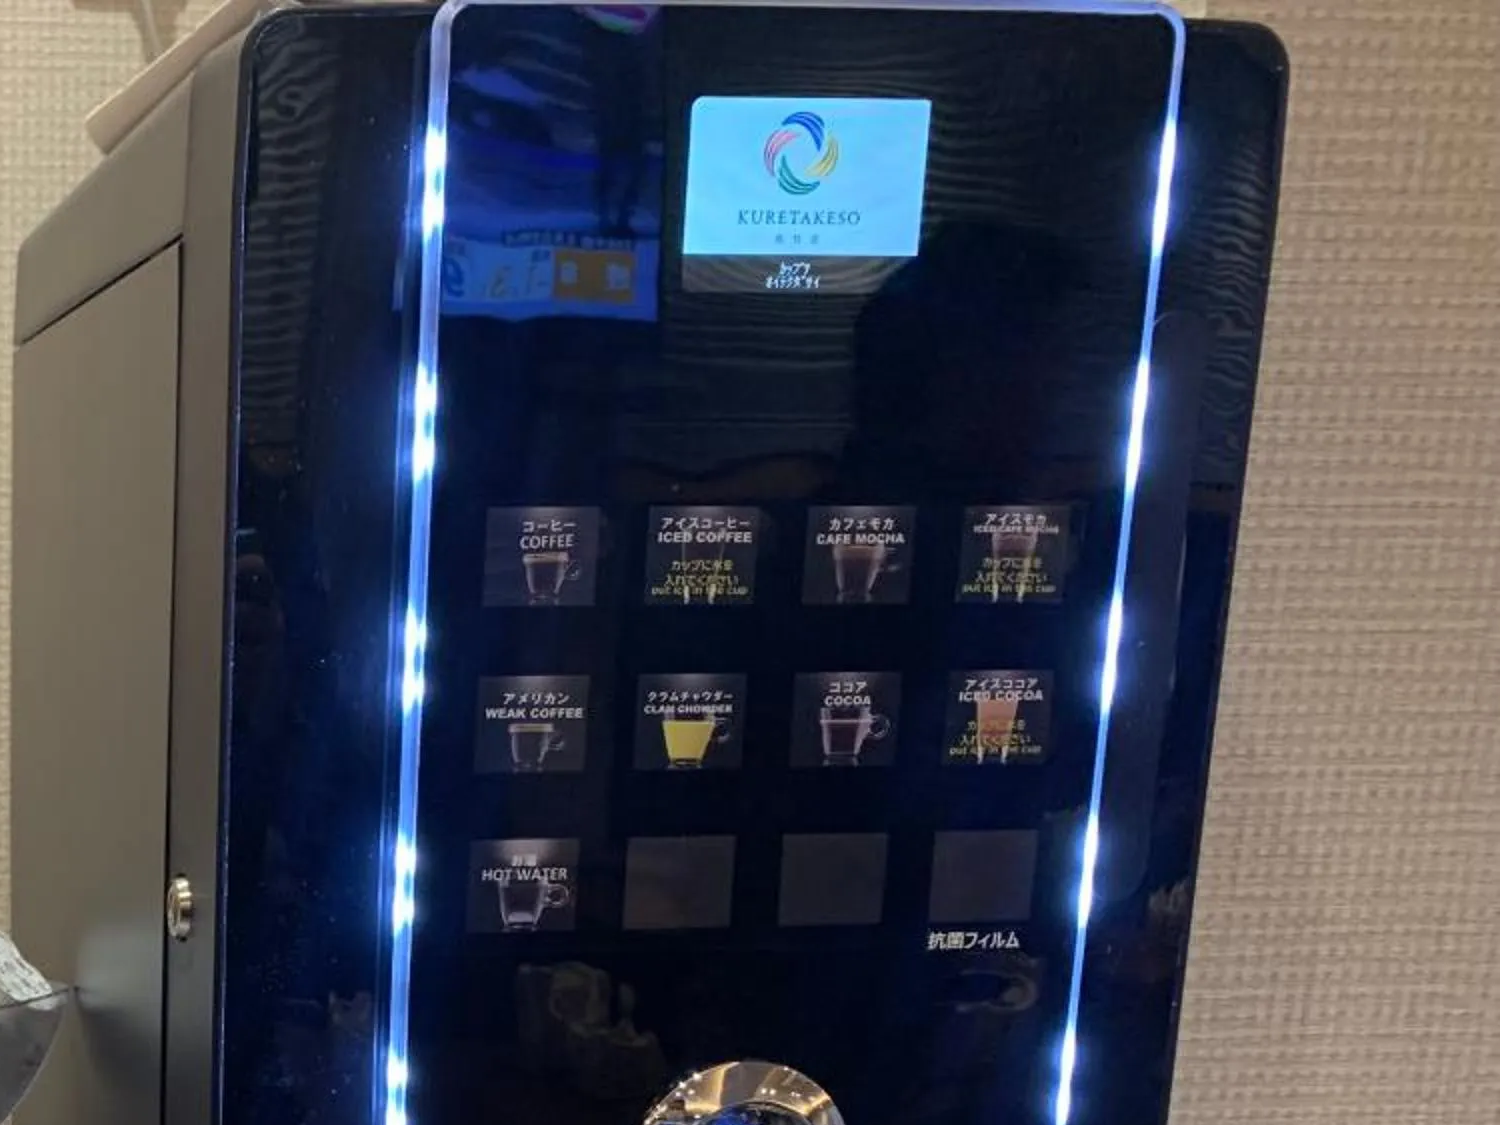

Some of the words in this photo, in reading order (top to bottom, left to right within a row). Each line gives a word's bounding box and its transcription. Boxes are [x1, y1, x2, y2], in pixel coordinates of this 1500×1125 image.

[737, 208, 861, 226] KURETAKESO
[521, 519, 577, 533] コーヒー
[660, 516, 751, 530] アイスコーヒー
[829, 517, 896, 532] カフェモカ
[985, 513, 1047, 526] アイスモカ
[519, 533, 574, 549] COFFEE
[657, 531, 692, 543] ICED
[696, 530, 752, 543] COFFEE
[816, 533, 851, 545] CAFE
[855, 532, 905, 544] MOCHA
[828, 681, 868, 694] ココア
[964, 677, 1038, 690] アイスココア
[503, 692, 570, 706] アメリカン
[824, 694, 871, 707] COCOA
[958, 690, 991, 702] ICED
[995, 690, 1043, 702] COCOA
[485, 707, 525, 719] WEAK
[529, 707, 584, 719] COFFEE
[481, 868, 512, 882] HOT
[516, 867, 568, 882] WATER
[927, 931, 1020, 950] 抗菌フィルム
